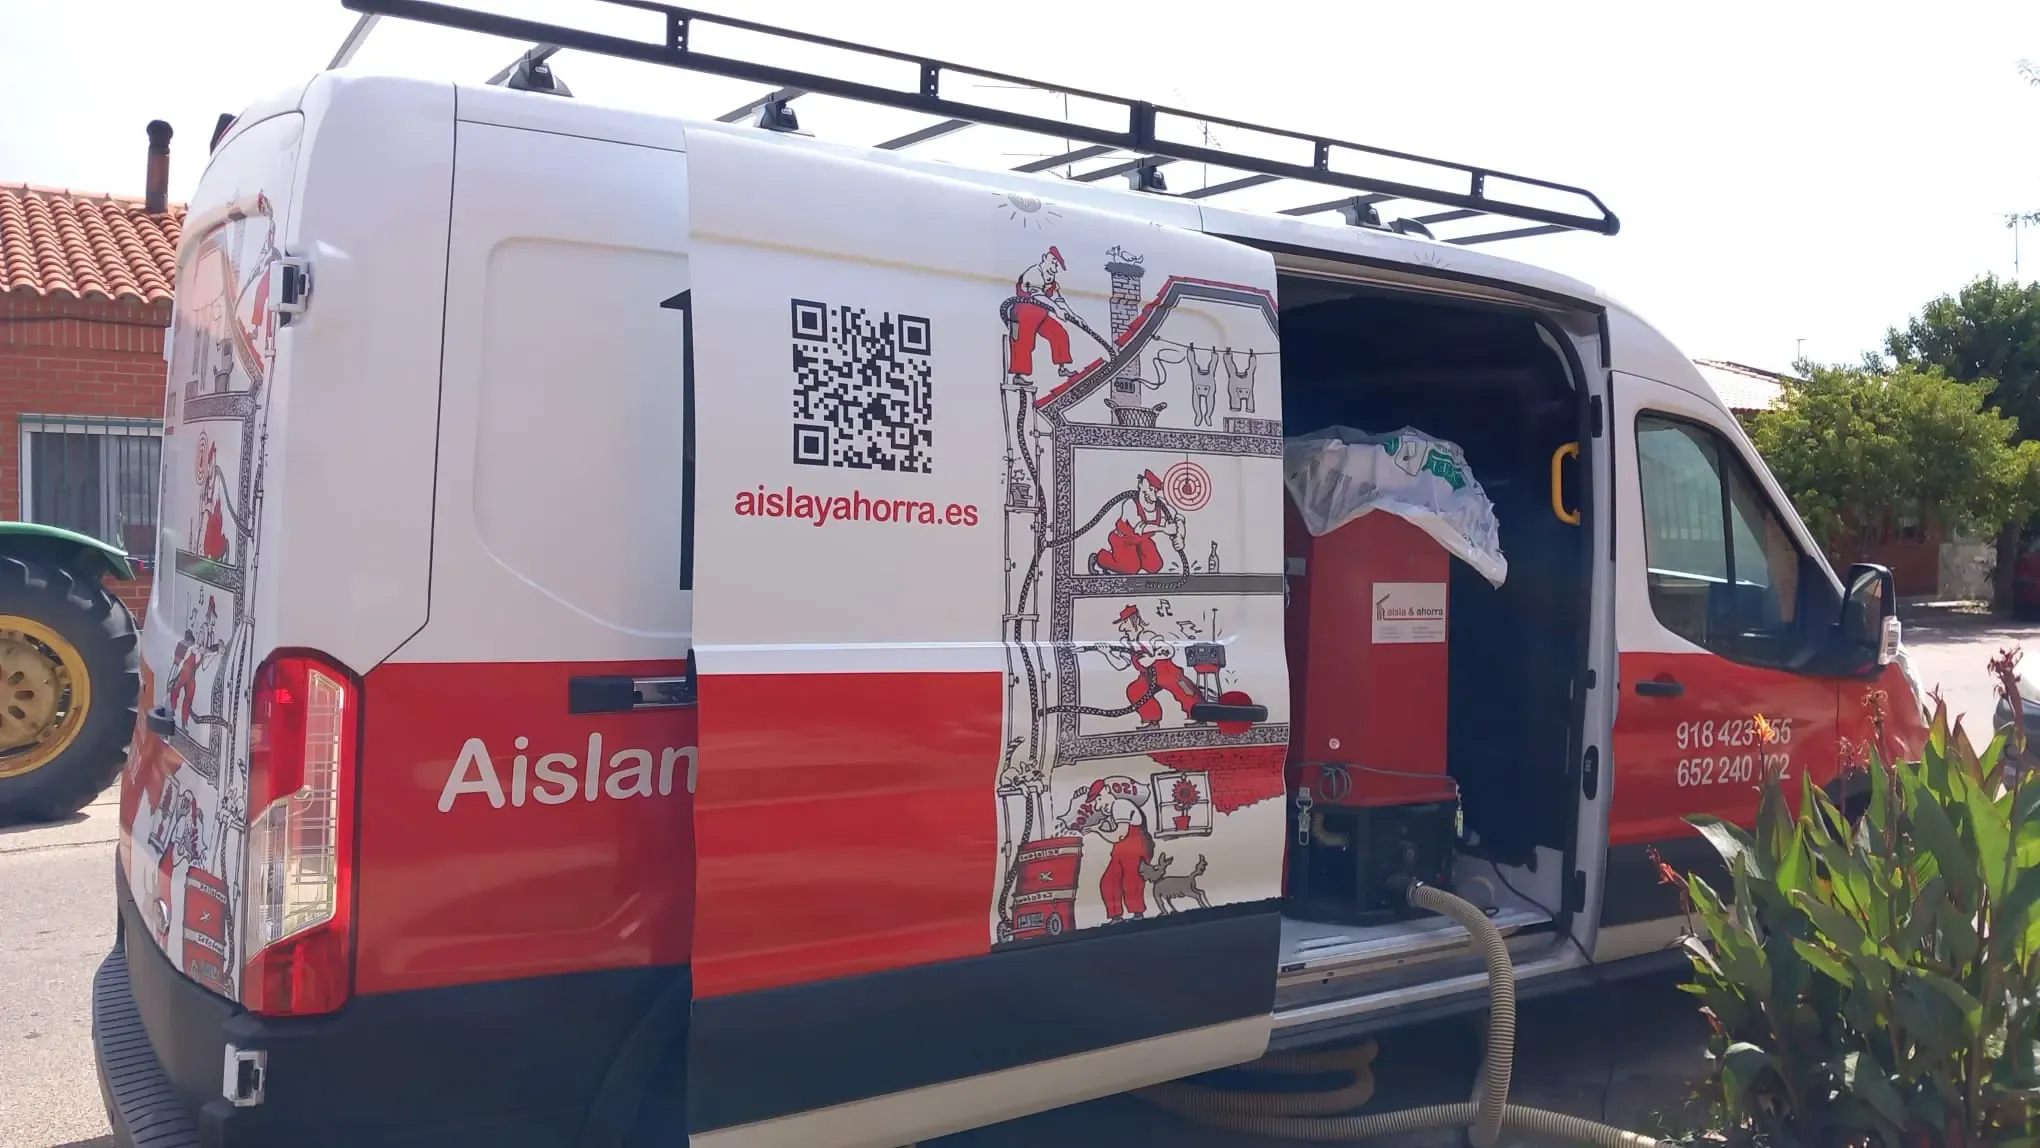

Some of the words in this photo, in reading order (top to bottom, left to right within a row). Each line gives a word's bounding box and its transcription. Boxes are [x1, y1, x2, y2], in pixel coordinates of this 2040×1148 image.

[735, 484, 978, 527] aislayahorra.es
[1416, 607, 1443, 616] ahorra
[1677, 721, 1714, 749] 918
[1718, 719, 1752, 747] 423
[1756, 718, 1792, 745] 55
[1678, 758, 1713, 787] 652
[1718, 755, 1752, 784] 240
